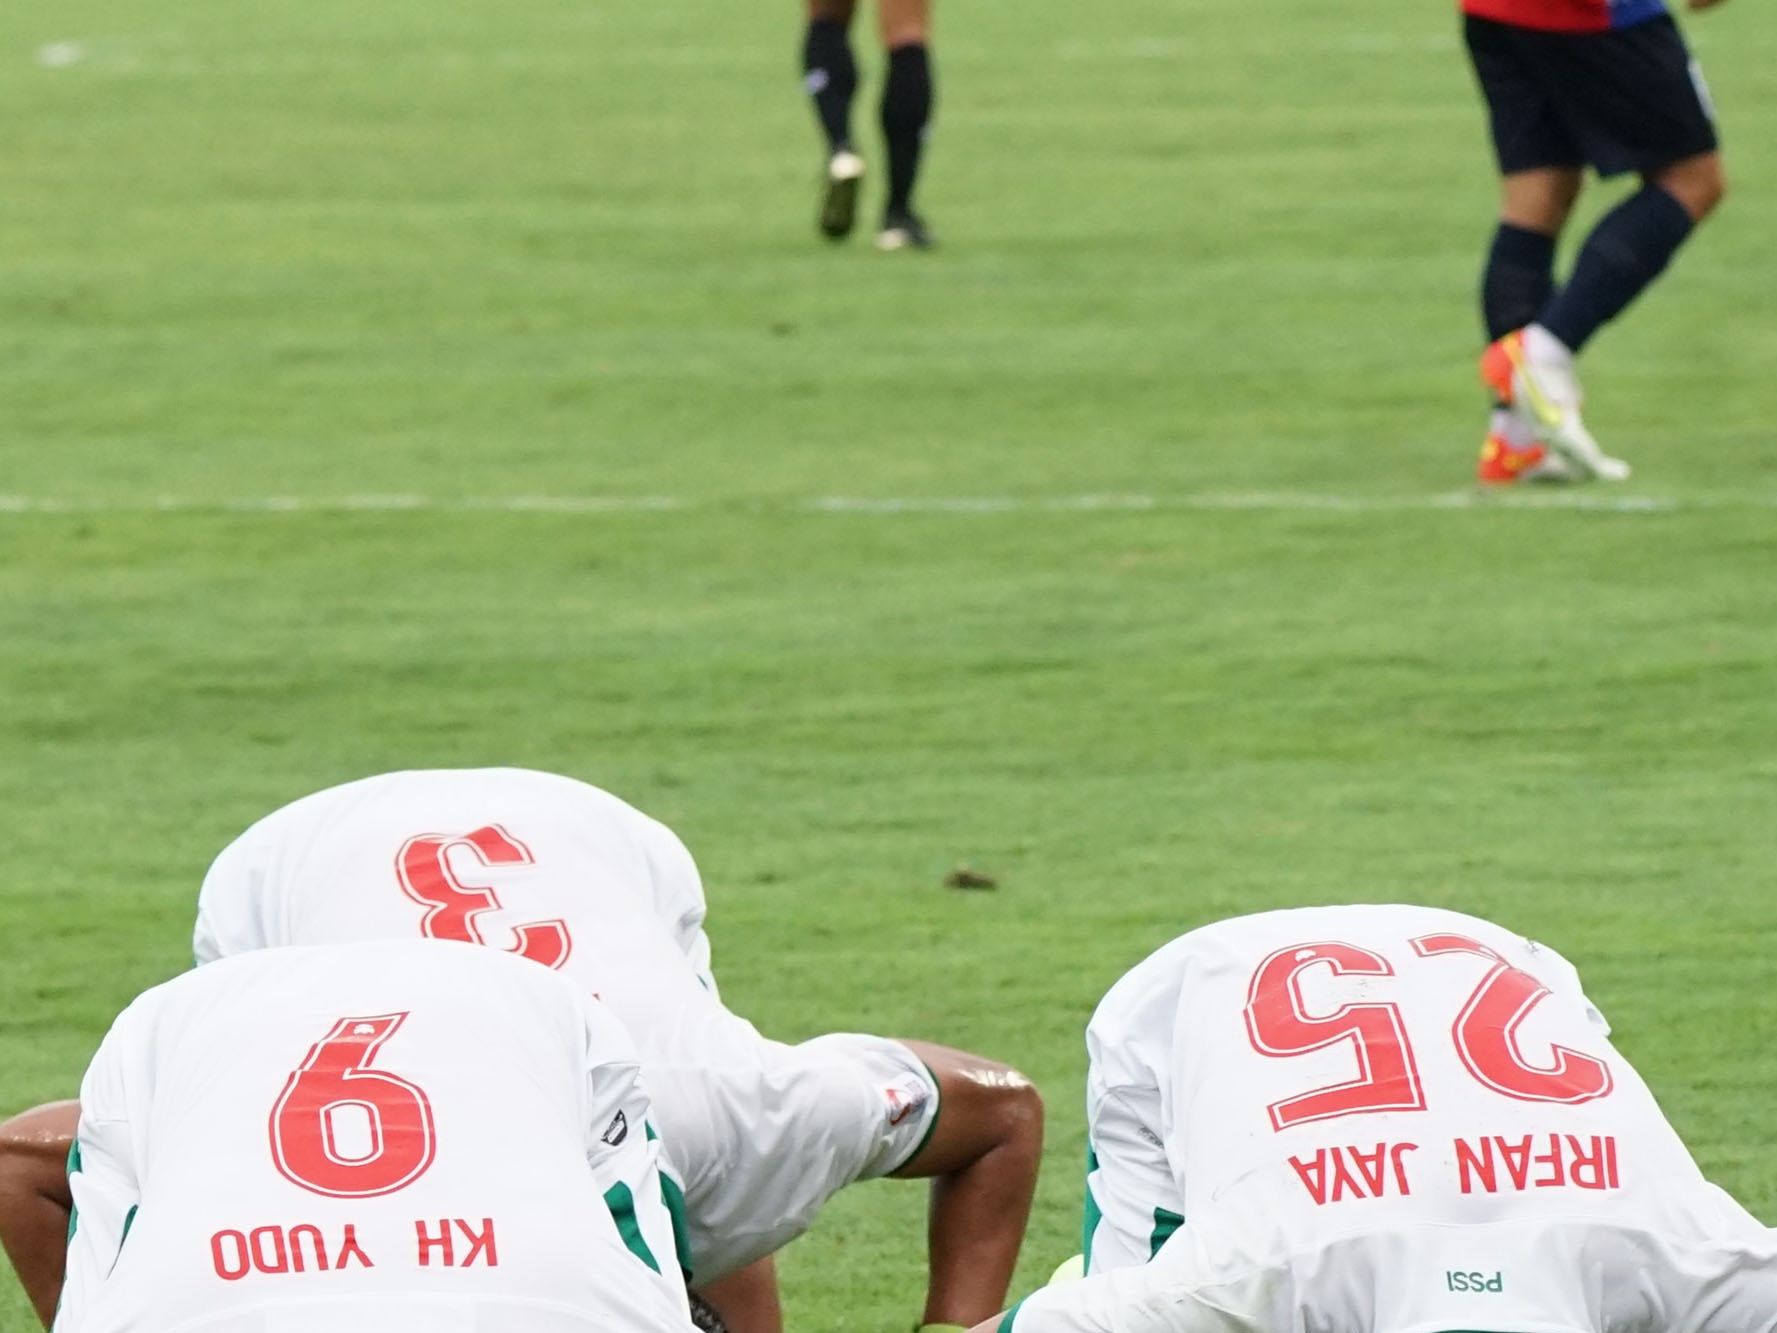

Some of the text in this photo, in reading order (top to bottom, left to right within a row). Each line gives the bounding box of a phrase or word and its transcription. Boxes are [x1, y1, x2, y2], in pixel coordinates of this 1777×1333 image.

[394, 824, 573, 969] 3
[1243, 934, 1615, 1133] 25
[268, 1012, 437, 1199] 9
[1288, 1133, 1620, 1205] IRFAN JAYA
[210, 1218, 499, 1281] KH YUDO
[1447, 1270, 1505, 1293] PSSI
